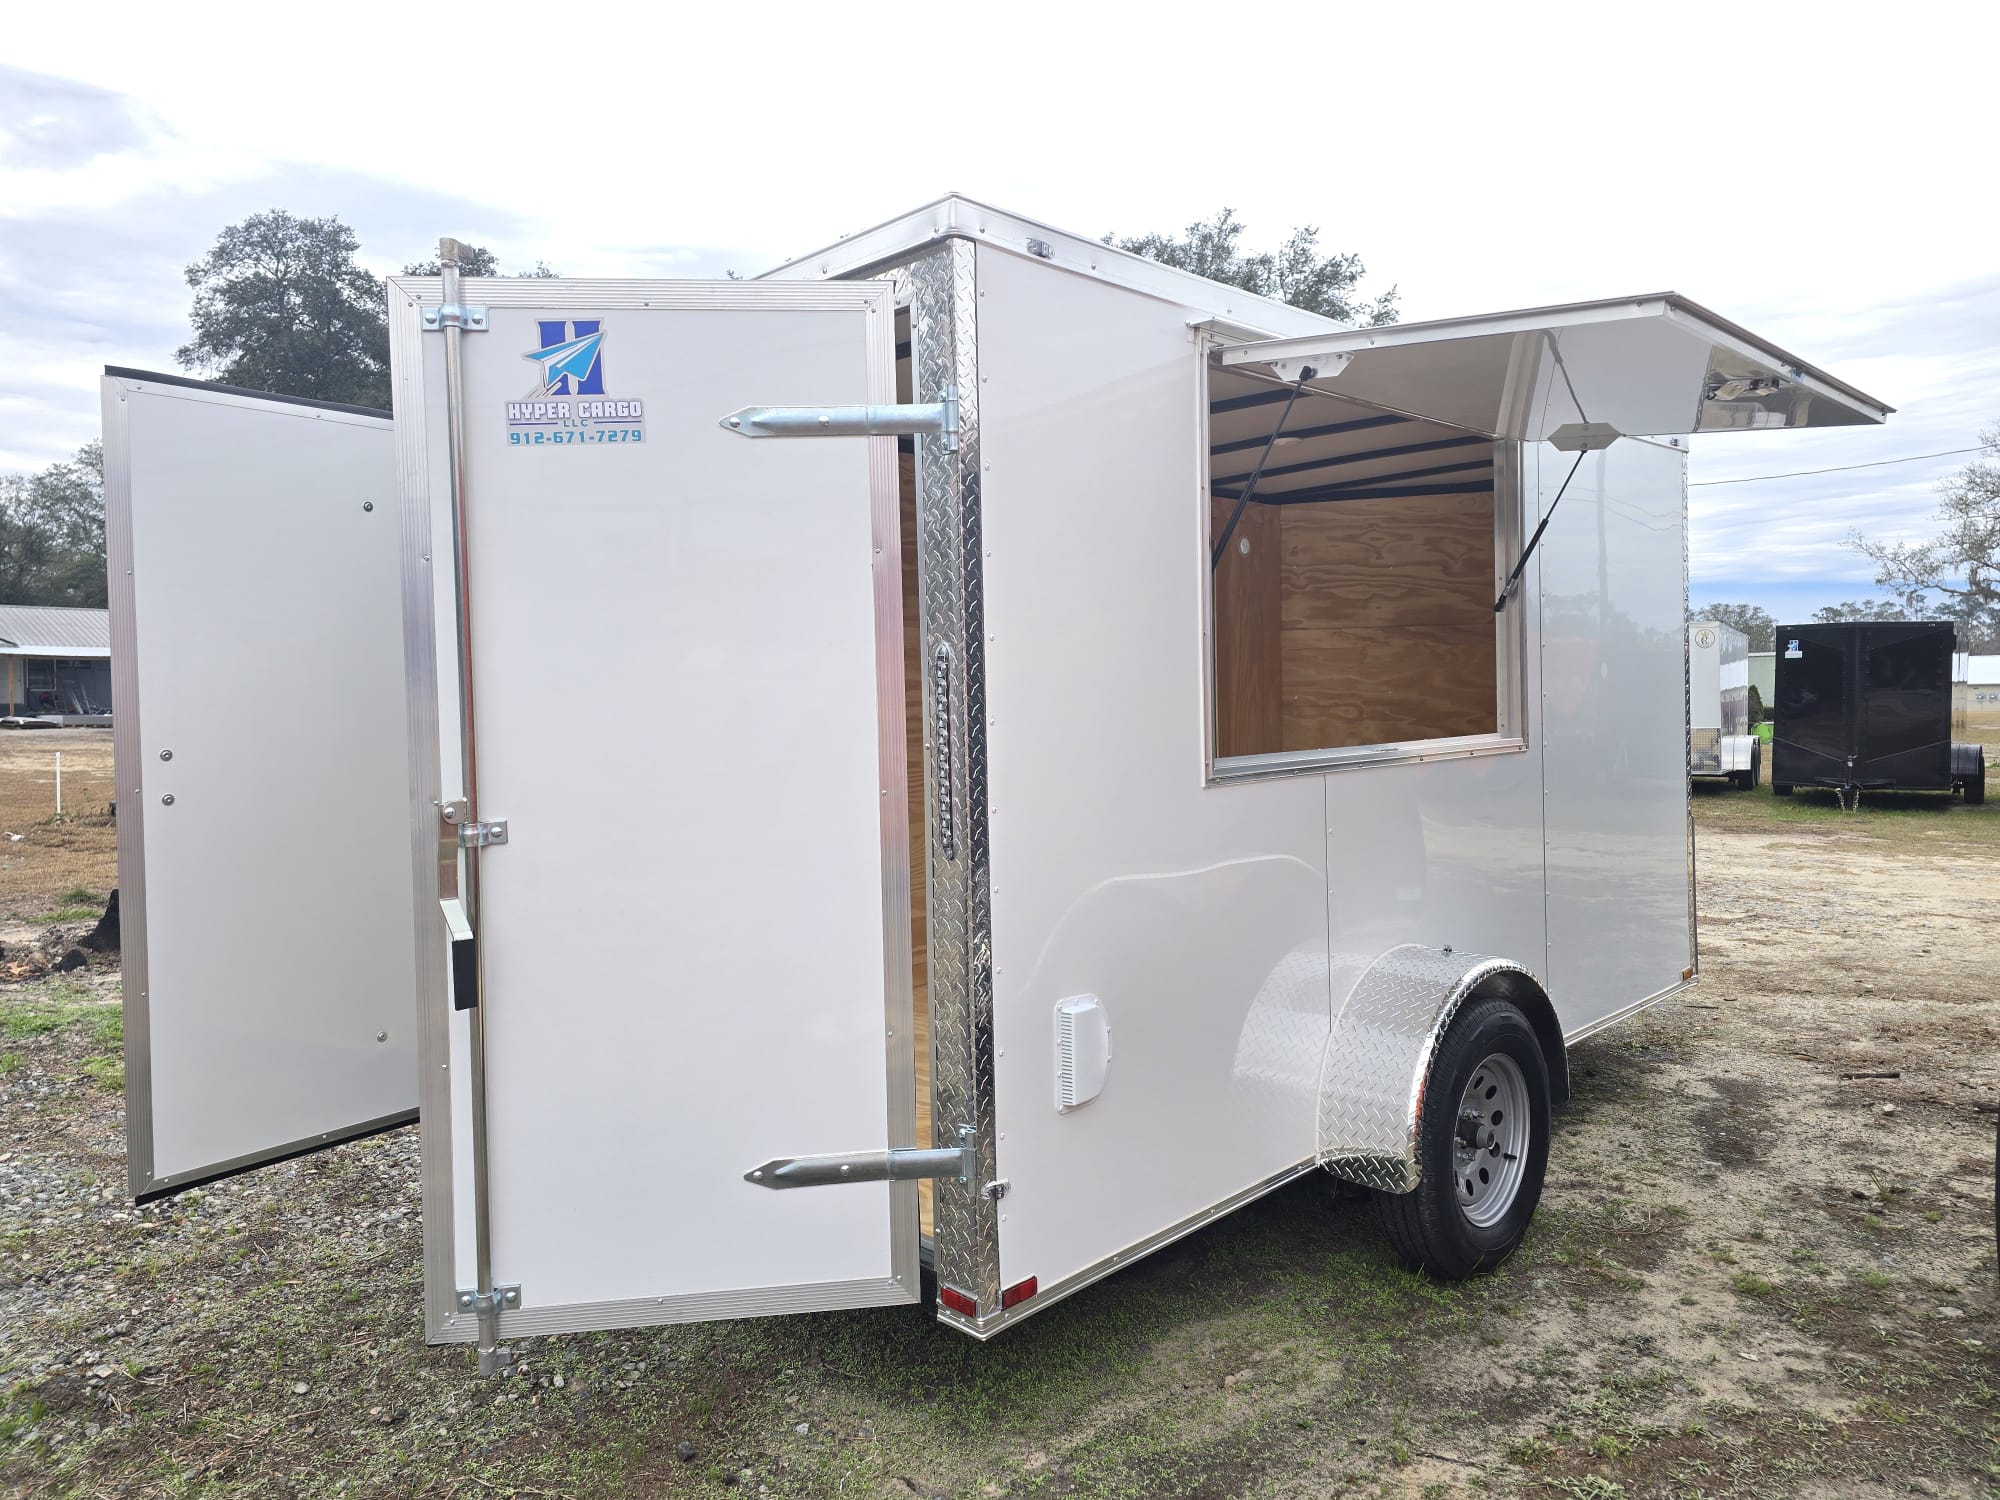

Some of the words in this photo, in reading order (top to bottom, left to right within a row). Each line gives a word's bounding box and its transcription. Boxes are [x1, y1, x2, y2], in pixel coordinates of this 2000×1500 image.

[507, 402, 571, 420] HYPER
[578, 401, 642, 418] CARGO
[563, 418, 588, 427] LLC
[509, 429, 642, 445] 912-671-7279
